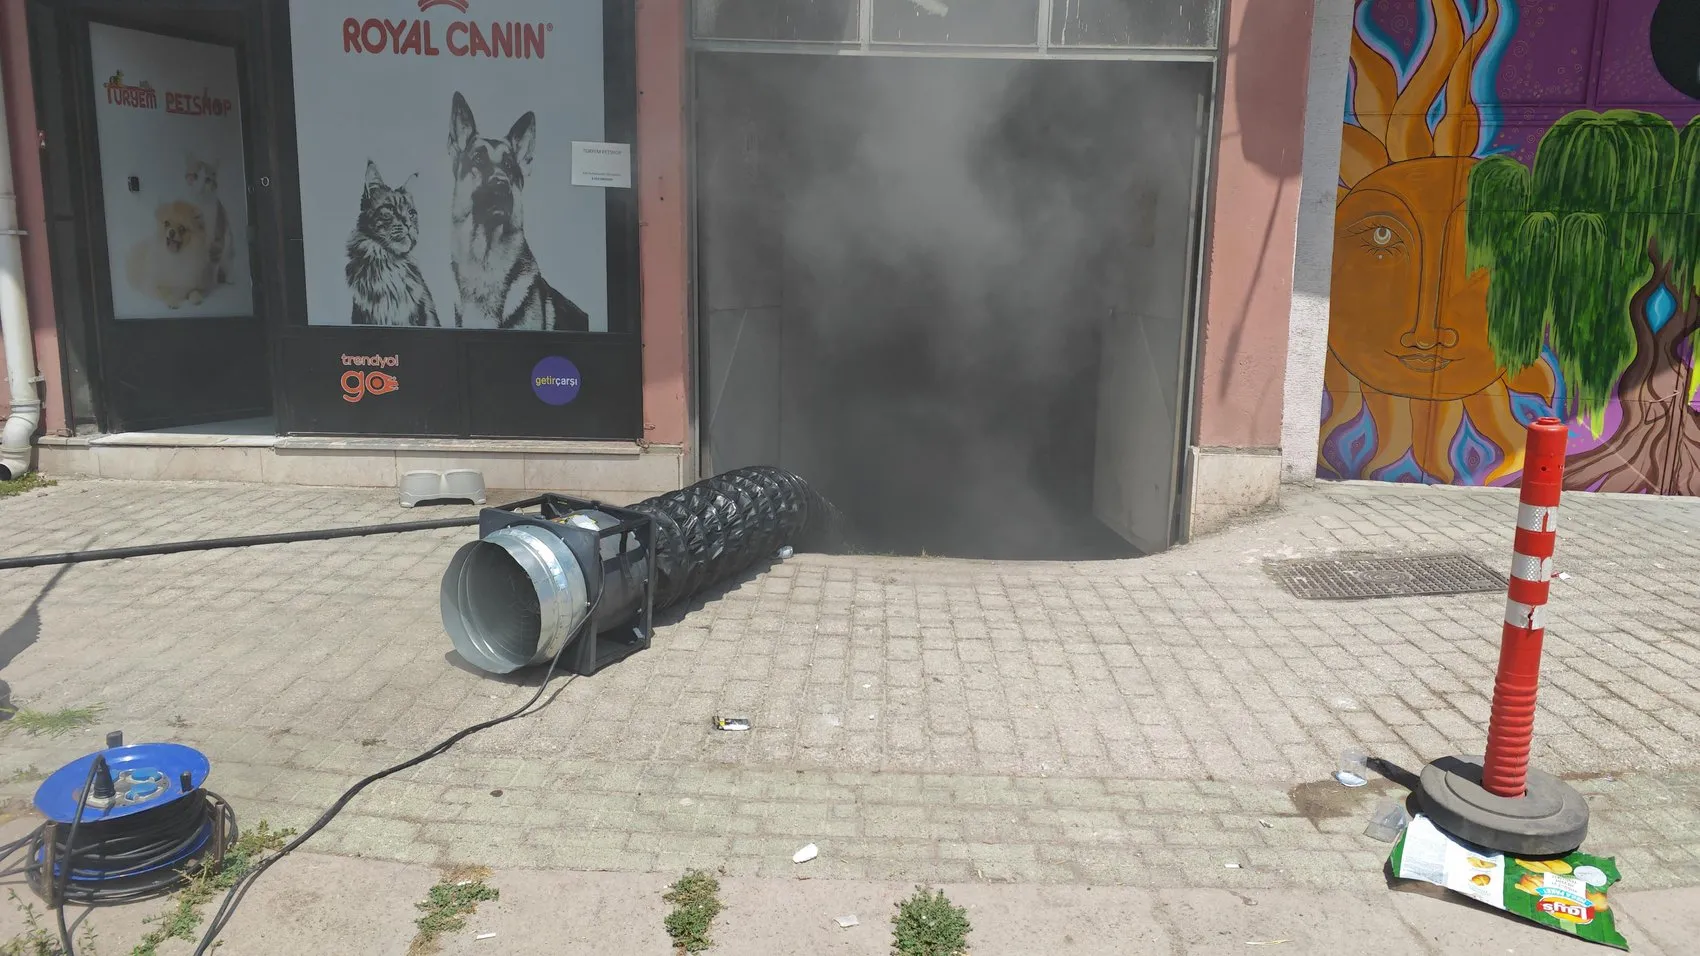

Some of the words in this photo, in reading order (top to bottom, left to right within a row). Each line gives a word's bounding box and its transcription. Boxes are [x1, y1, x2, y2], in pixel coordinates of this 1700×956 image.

[343, 18, 440, 56] ROYAL
[165, 88, 232, 117] PETSHOP
[341, 353, 399, 368] trendyol
[340, 370, 399, 403] go
[1542, 901, 1588, 920] Lay's
